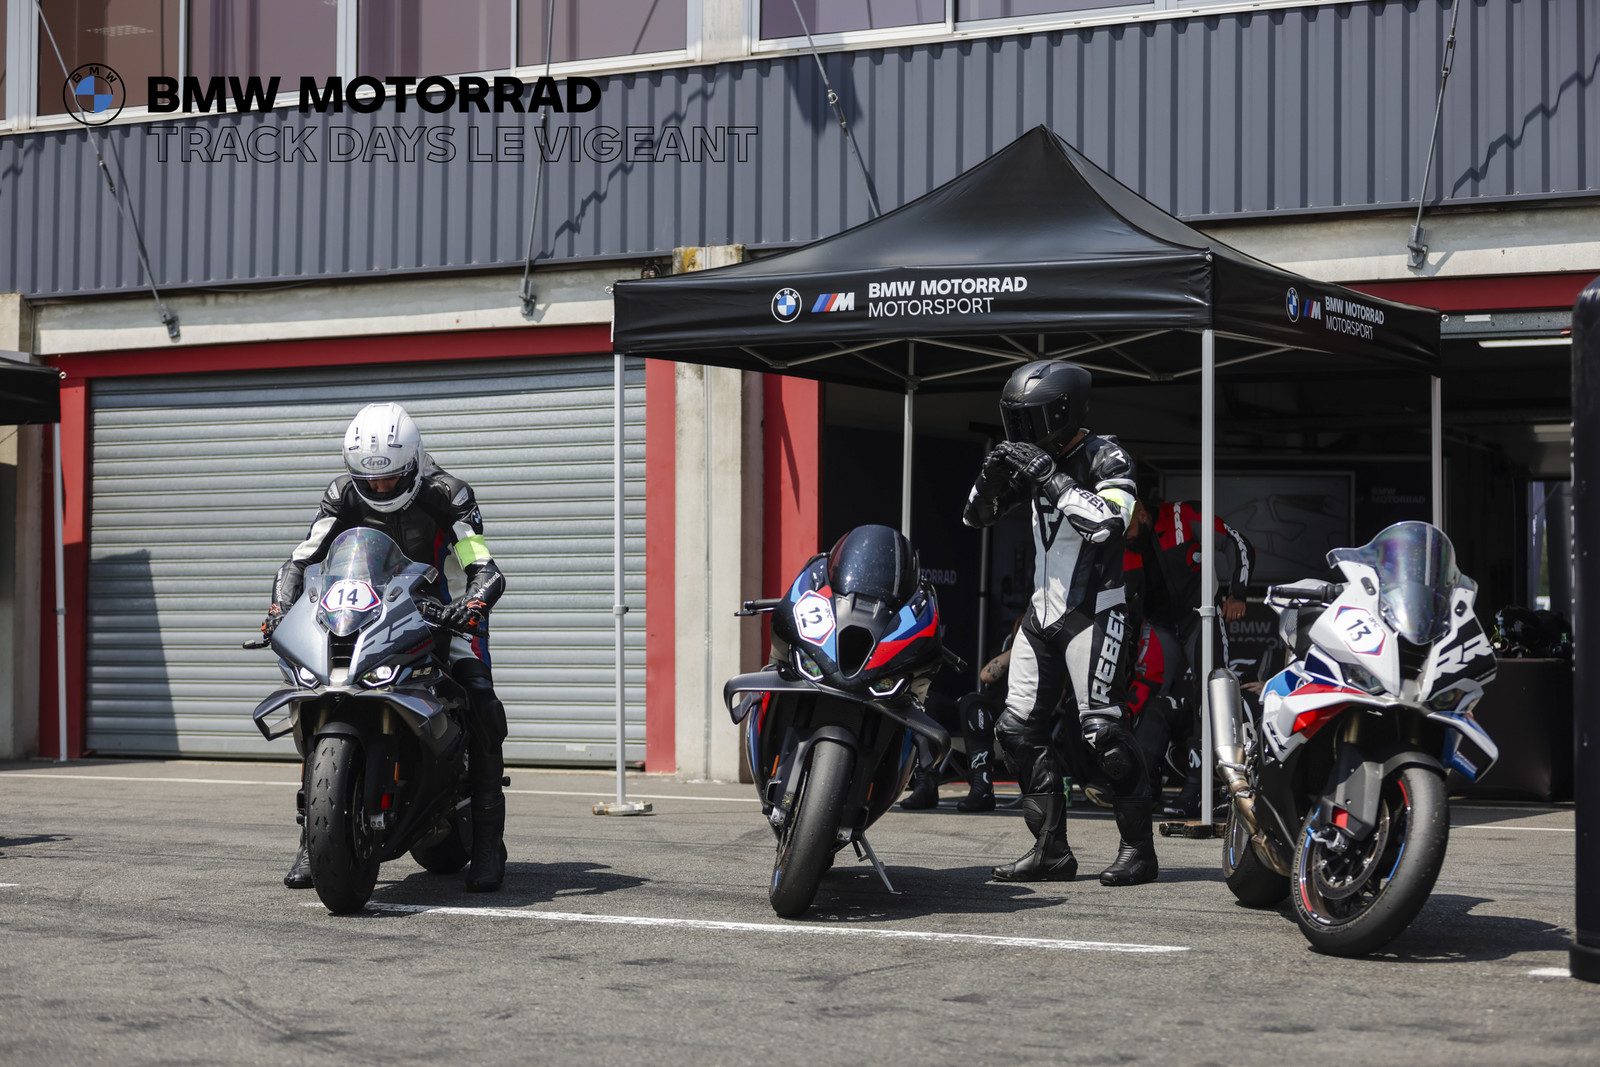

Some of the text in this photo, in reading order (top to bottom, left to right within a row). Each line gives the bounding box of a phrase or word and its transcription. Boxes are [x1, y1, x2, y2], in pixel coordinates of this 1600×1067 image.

[868, 276, 1028, 298] BMW MOTORRAD
[868, 297, 995, 318] MOTORSPORT
[1325, 296, 1385, 325] BMW MOTORRAD
[1326, 315, 1374, 340] MOTORSPORT
[362, 456, 388, 467] Arai
[337, 588, 359, 605] 14
[800, 606, 823, 629] 12
[1229, 621, 1271, 634] BMW
[1345, 618, 1372, 642] 13
